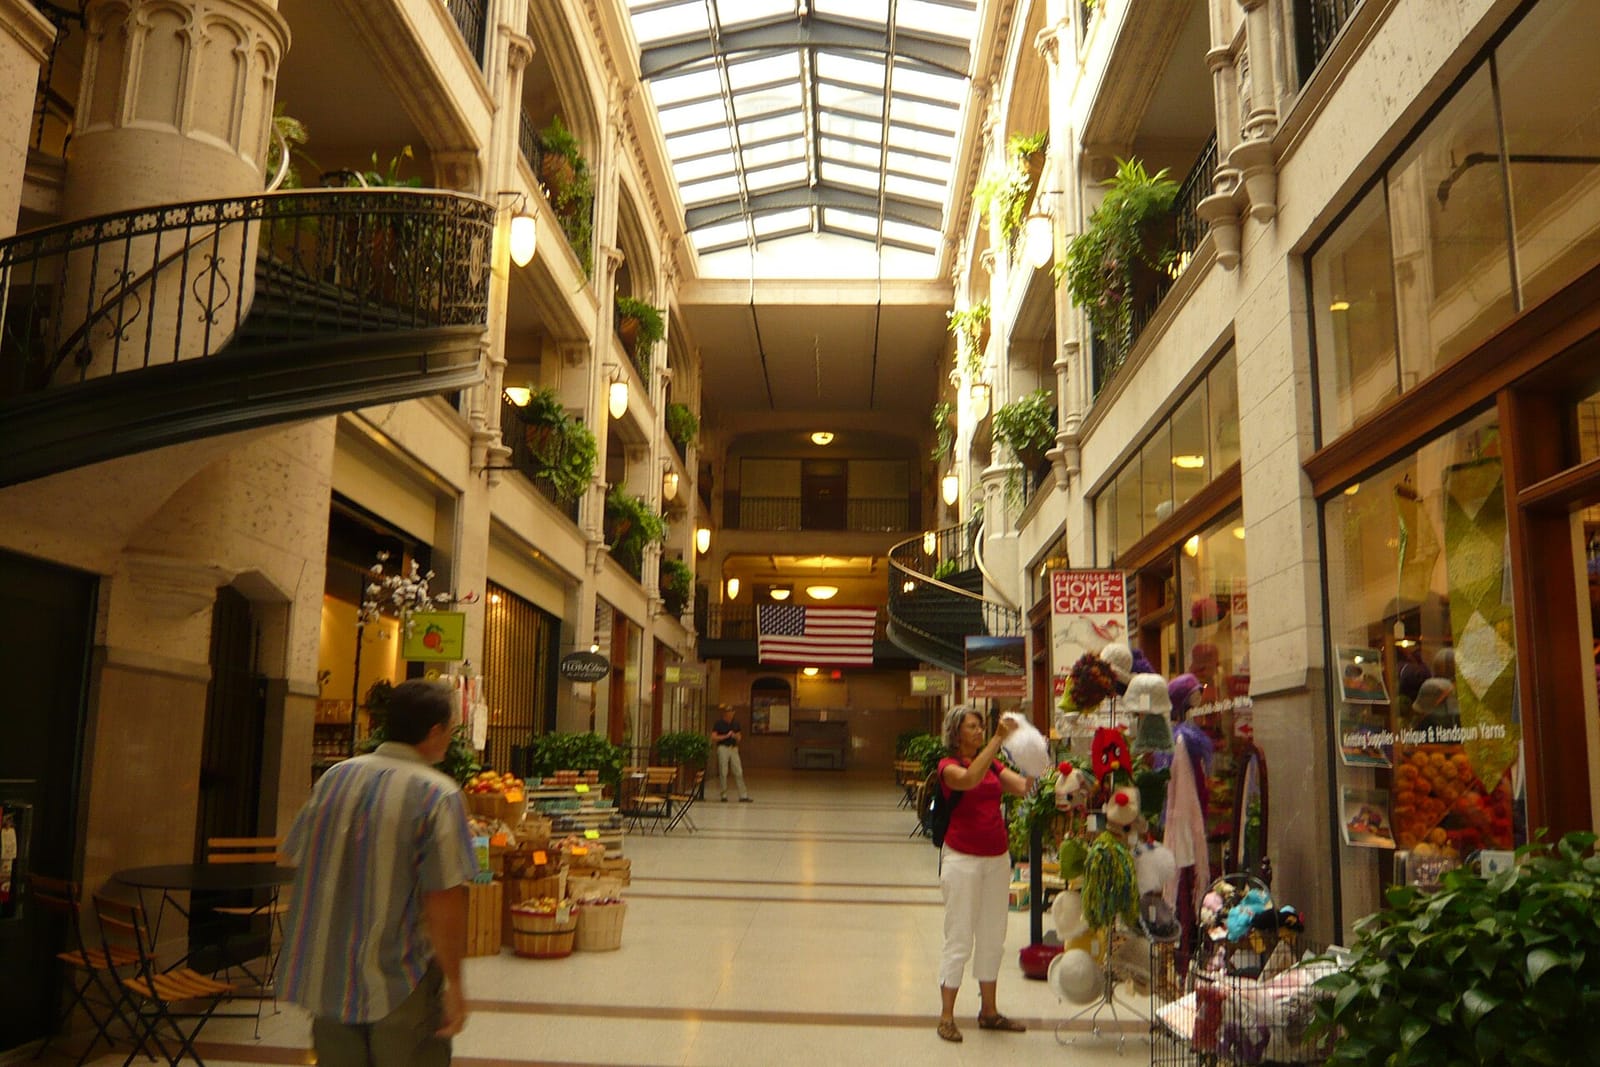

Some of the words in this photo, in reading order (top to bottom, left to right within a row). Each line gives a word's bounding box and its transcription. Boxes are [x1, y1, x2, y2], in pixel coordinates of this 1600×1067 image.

[1055, 574, 1105, 582] ASHEVILLE
[1056, 597, 1122, 613] CRAFTS
[1367, 730, 1394, 748] Supplies
[1400, 728, 1426, 746] Unique
[1427, 726, 1435, 742] &
[1436, 724, 1477, 744] Handspun
[1479, 723, 1505, 739] Yarns
